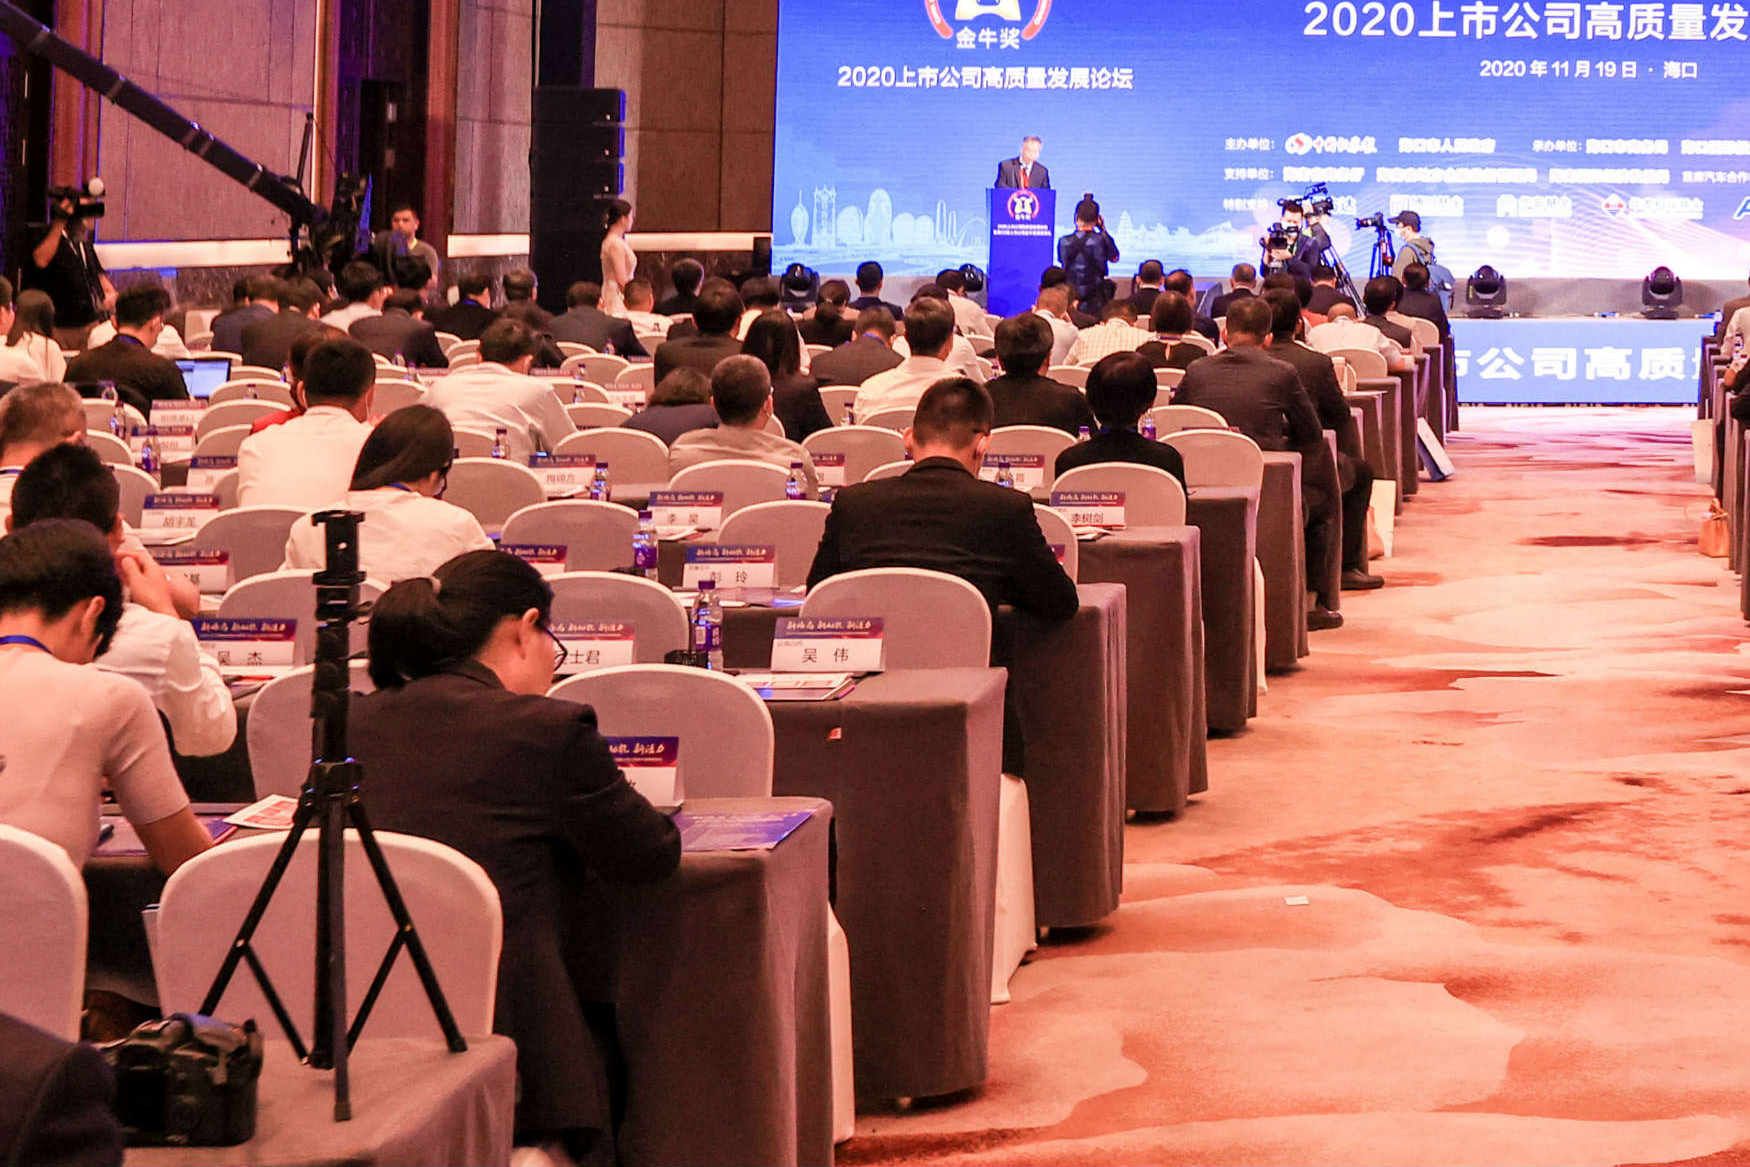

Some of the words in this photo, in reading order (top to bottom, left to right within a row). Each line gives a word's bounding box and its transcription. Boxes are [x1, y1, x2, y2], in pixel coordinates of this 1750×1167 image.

[955, 26, 1020, 49] 金牛奖
[837, 66, 1134, 89] 2020上市公司高质量发展论坛
[1455, 346, 1700, 381] 公司高质
